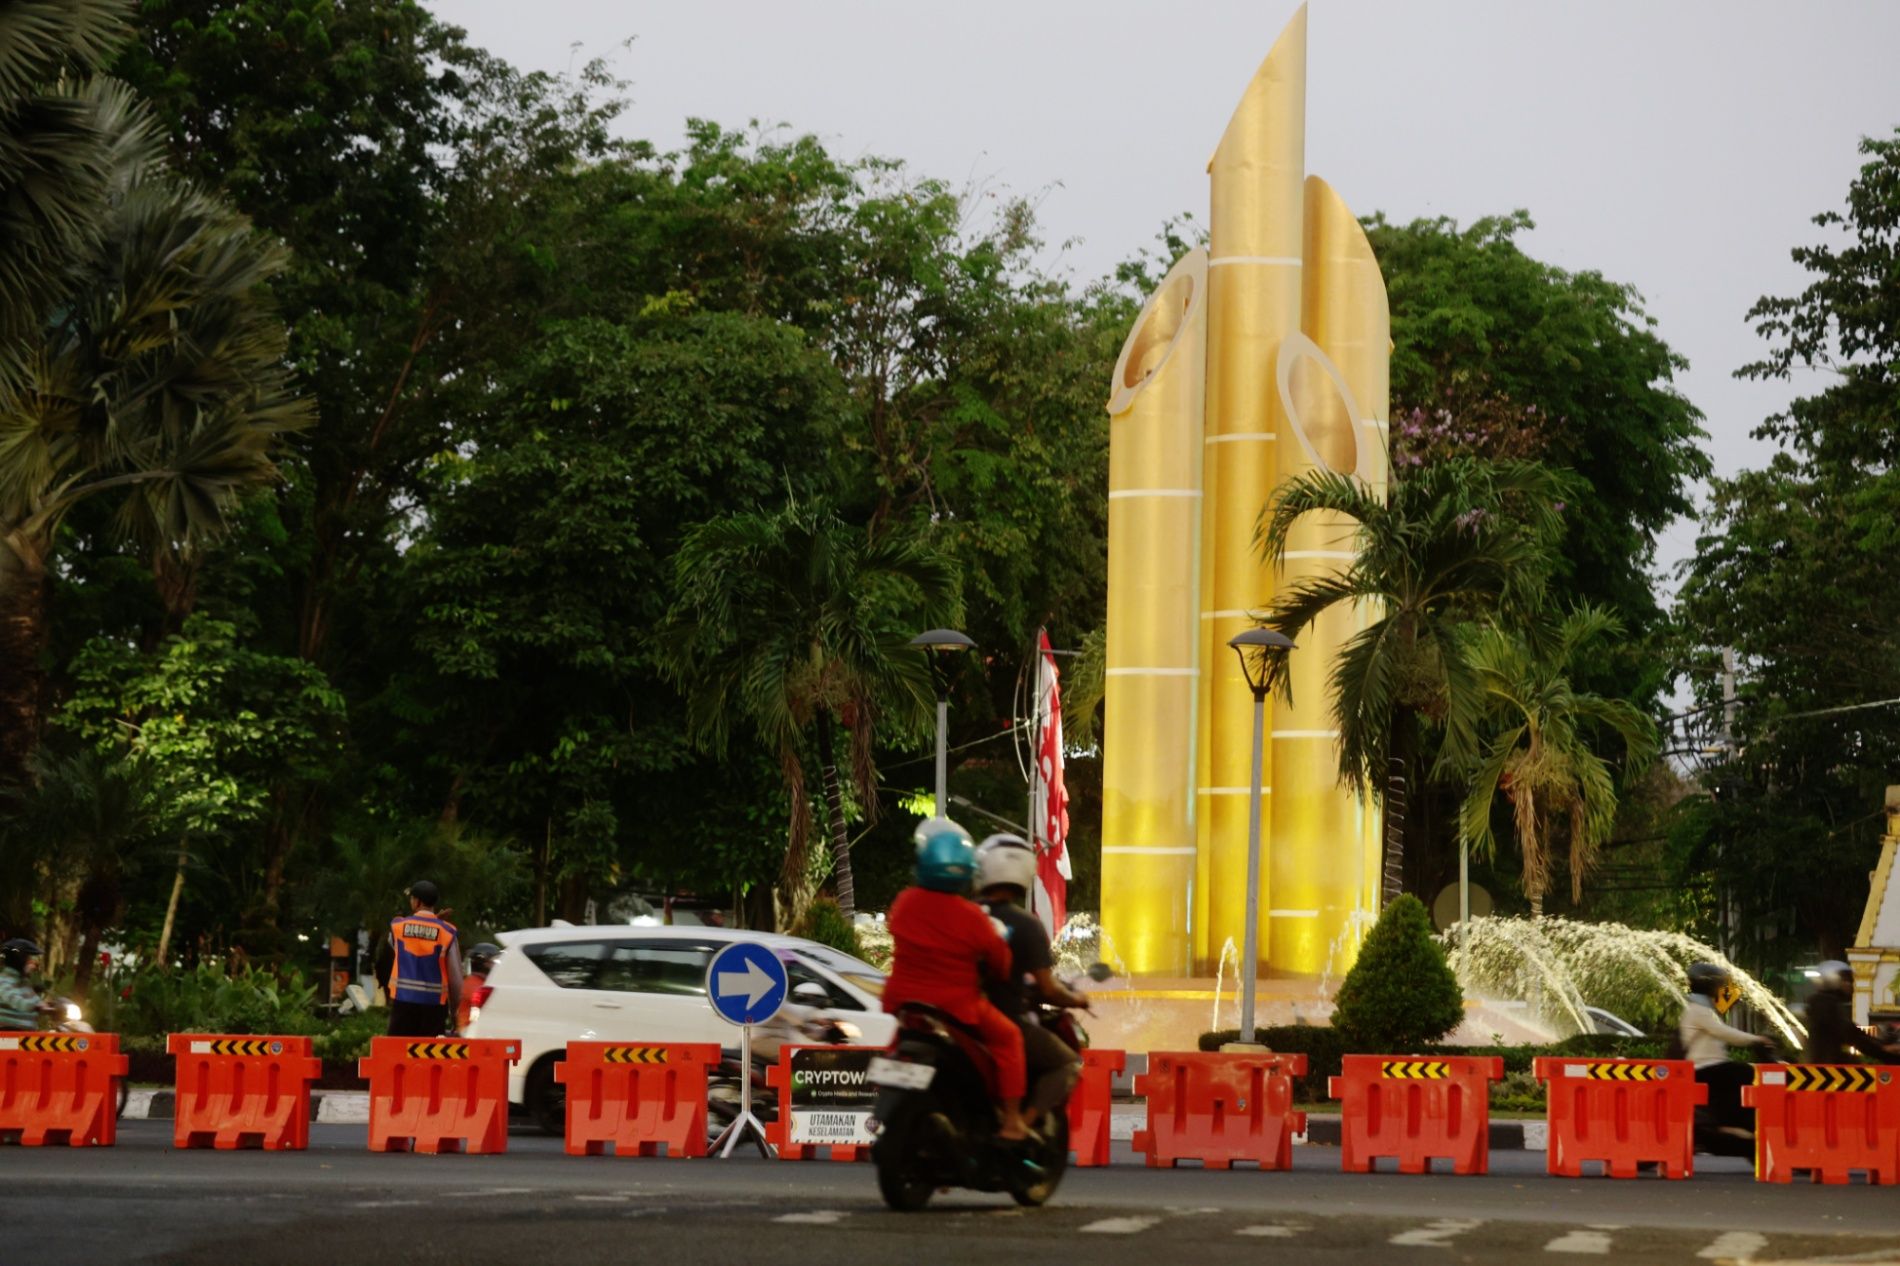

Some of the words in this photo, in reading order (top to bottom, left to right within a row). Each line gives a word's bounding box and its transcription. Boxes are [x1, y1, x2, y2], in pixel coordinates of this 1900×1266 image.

[794, 1070, 866, 1085] CRYPTOW
[809, 1114, 856, 1126] UTAMAKAN
[808, 1126, 854, 1136] KESELAMATAN
